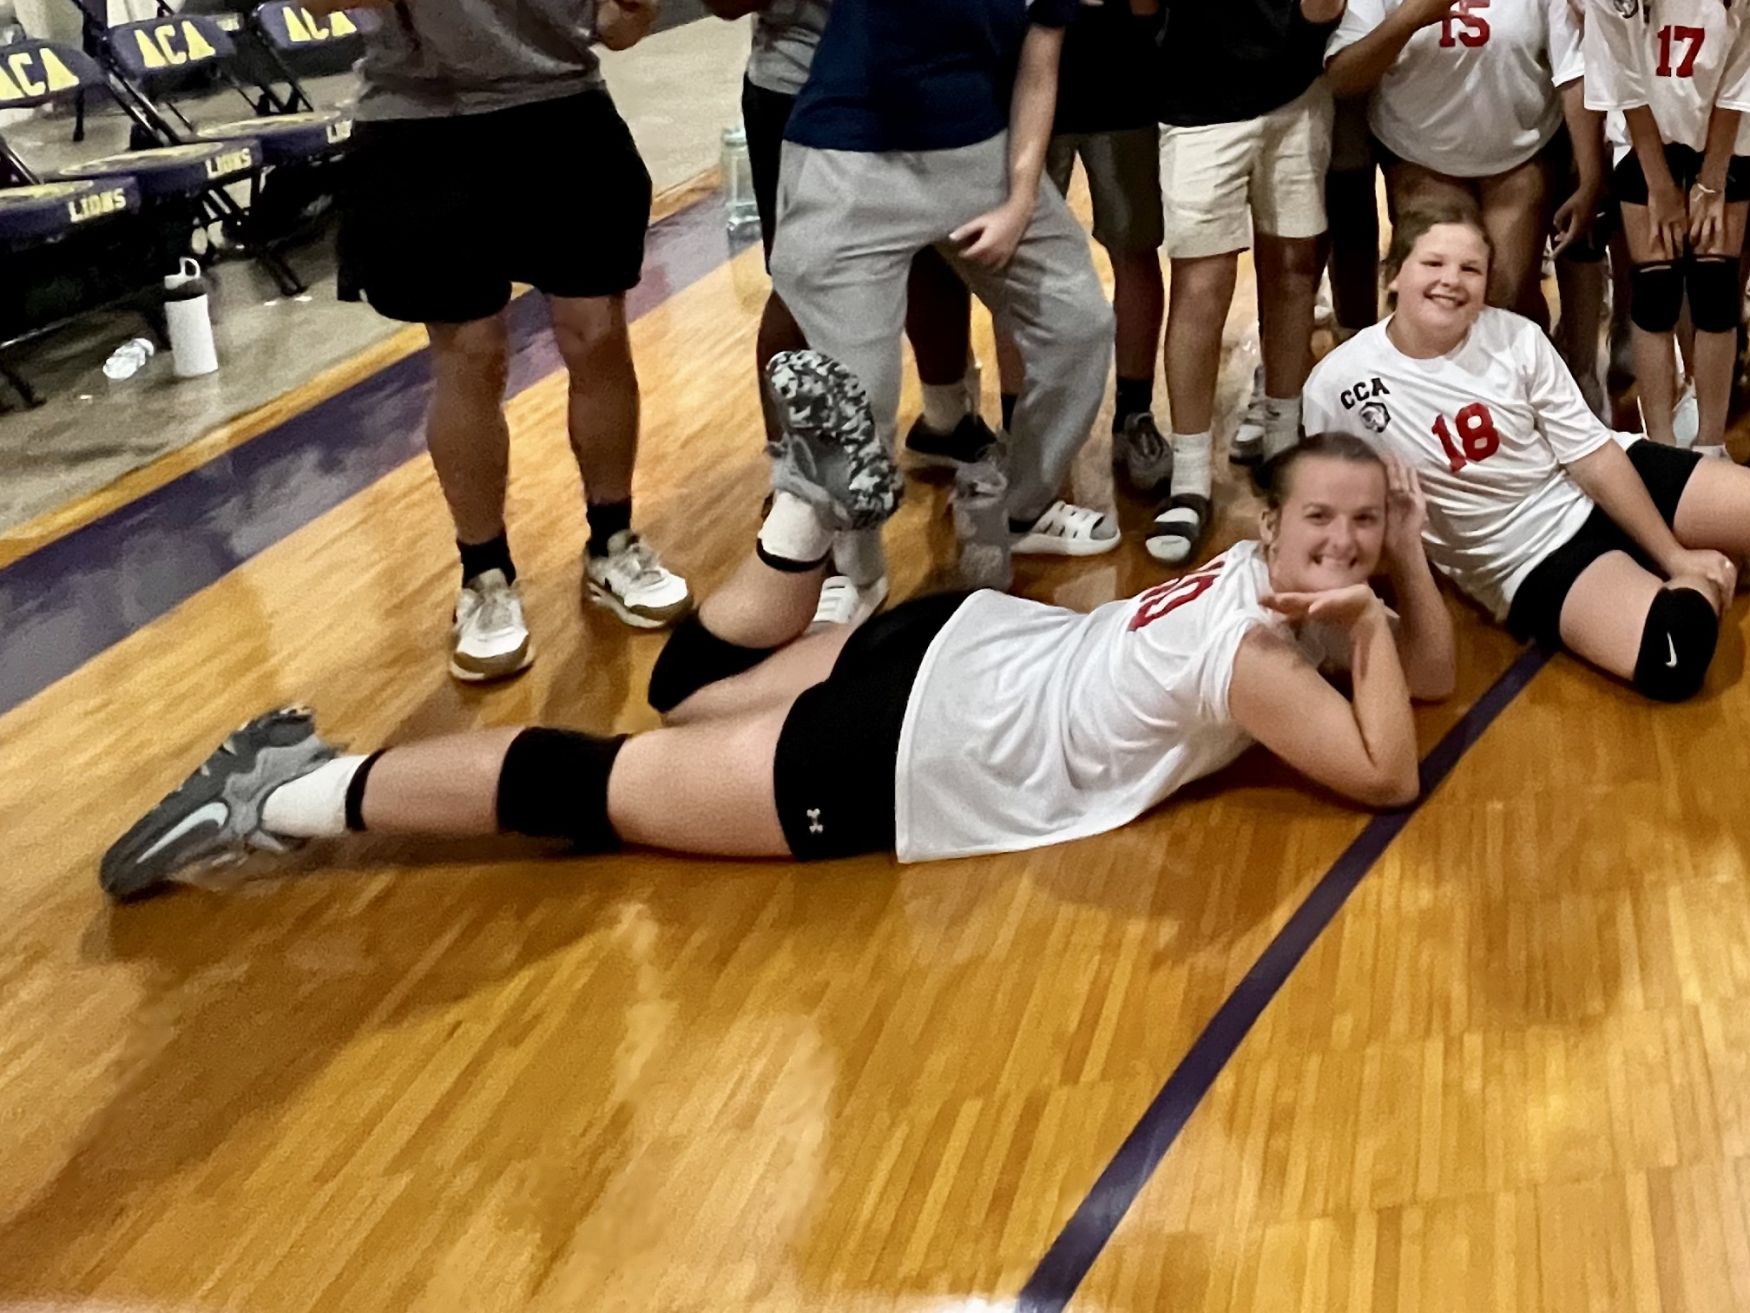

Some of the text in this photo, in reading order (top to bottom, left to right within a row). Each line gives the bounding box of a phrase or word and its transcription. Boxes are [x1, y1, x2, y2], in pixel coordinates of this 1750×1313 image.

[134, 20, 216, 69] ACA
[1655, 24, 1706, 79] 17
[68, 187, 127, 224] LIONS
[1340, 377, 1391, 410] CCA
[1431, 402, 1500, 473] 18
